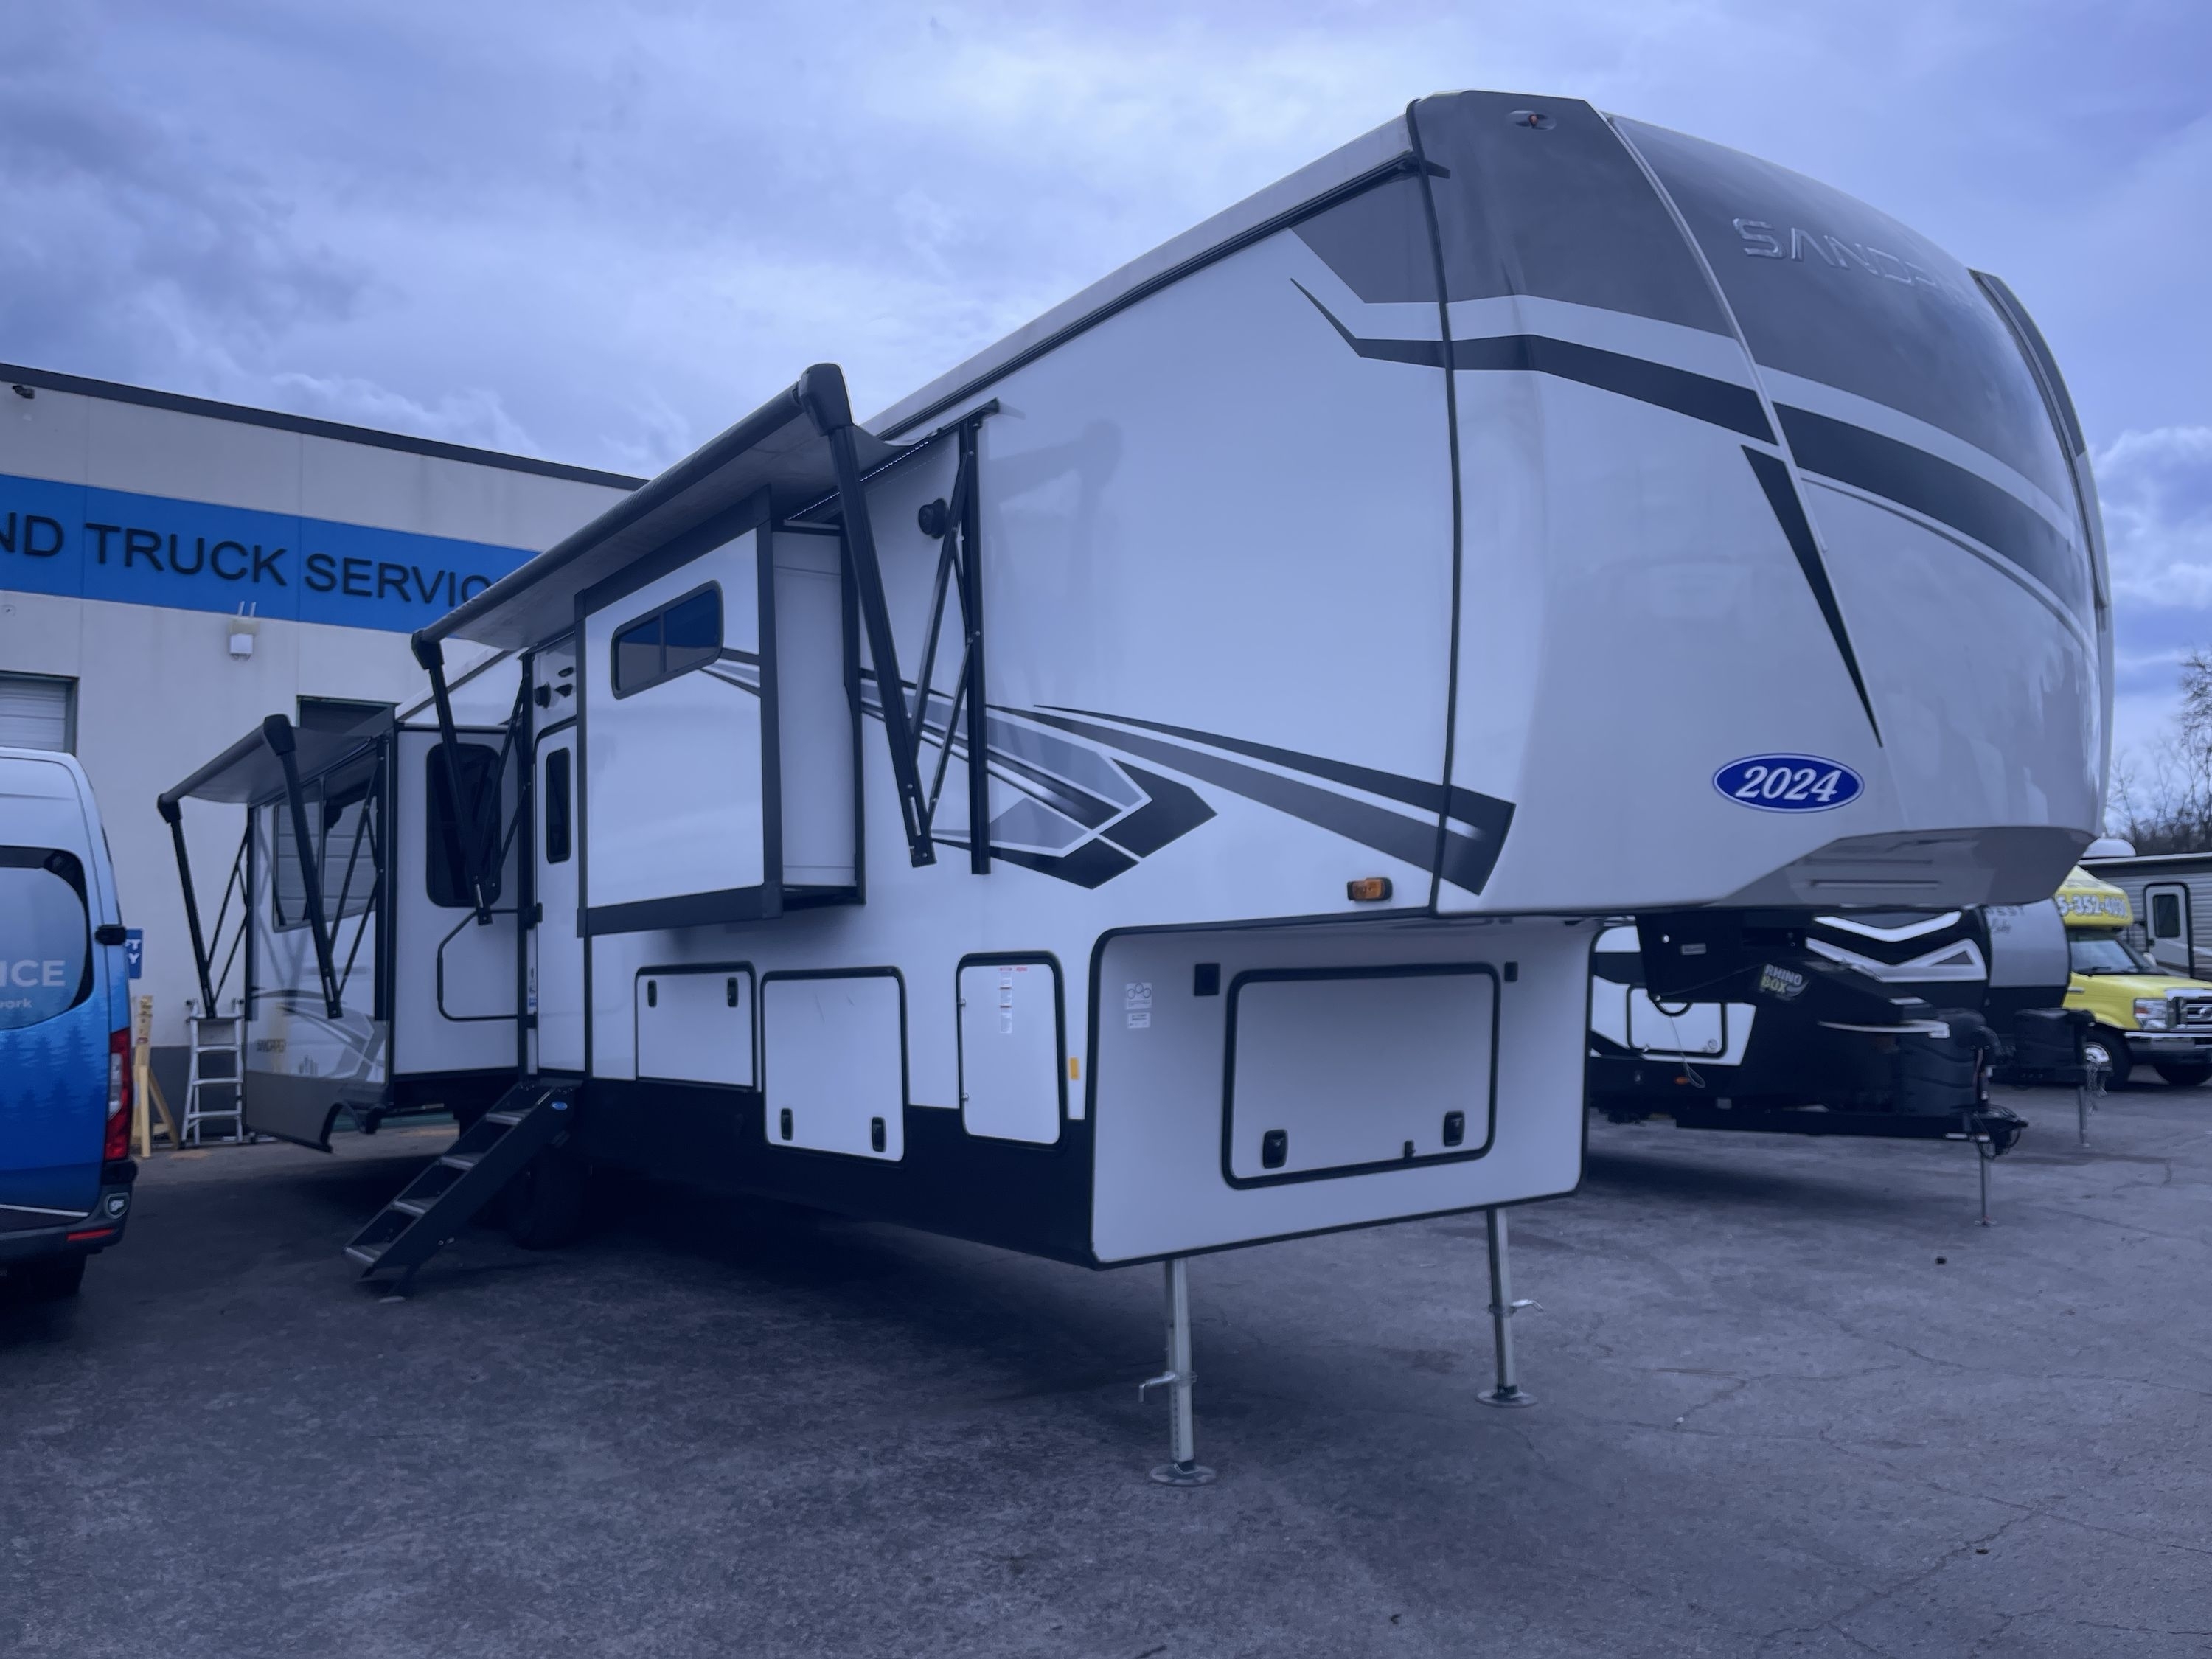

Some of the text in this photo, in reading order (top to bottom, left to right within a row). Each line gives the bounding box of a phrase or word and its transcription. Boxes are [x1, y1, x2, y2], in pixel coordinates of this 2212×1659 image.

[85, 522, 288, 587] TRUCK
[305, 553, 504, 607] SERVIC
[1735, 765, 1842, 802] 2024
